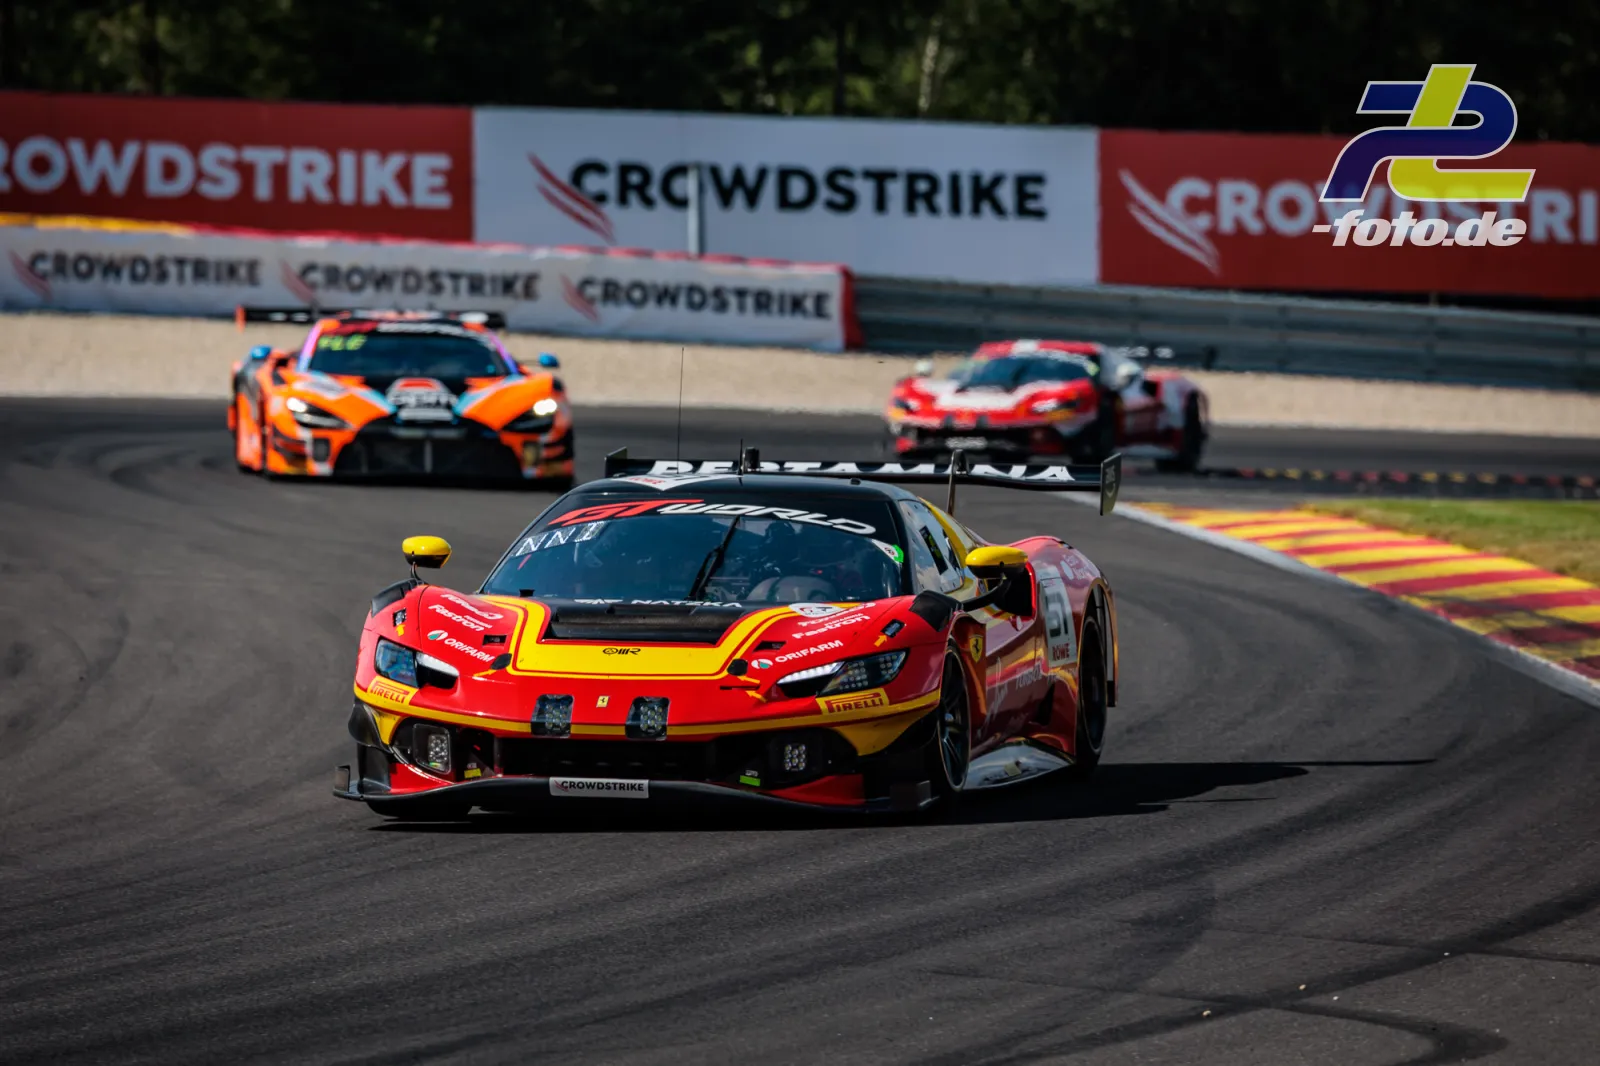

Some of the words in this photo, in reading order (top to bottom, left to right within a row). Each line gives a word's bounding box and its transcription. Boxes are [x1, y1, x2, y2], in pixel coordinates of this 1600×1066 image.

[0, 134, 453, 209] OWDSTRIKE
[569, 158, 1048, 220] CROWDSTRIKE
[27, 250, 263, 288] CROWDSTRIKE
[299, 261, 541, 301] CROWDSTRIKE
[576, 275, 833, 320] CROWDSTRIKE
[548, 499, 704, 527] GT
[656, 503, 877, 535] WORLD
[444, 638, 496, 662] ORIFARM
[774, 639, 844, 663] ORIFARM
[370, 680, 410, 704] PIRELLI
[825, 692, 883, 713] PIRELLI
[560, 780, 645, 792] CROWDSTRIKE
